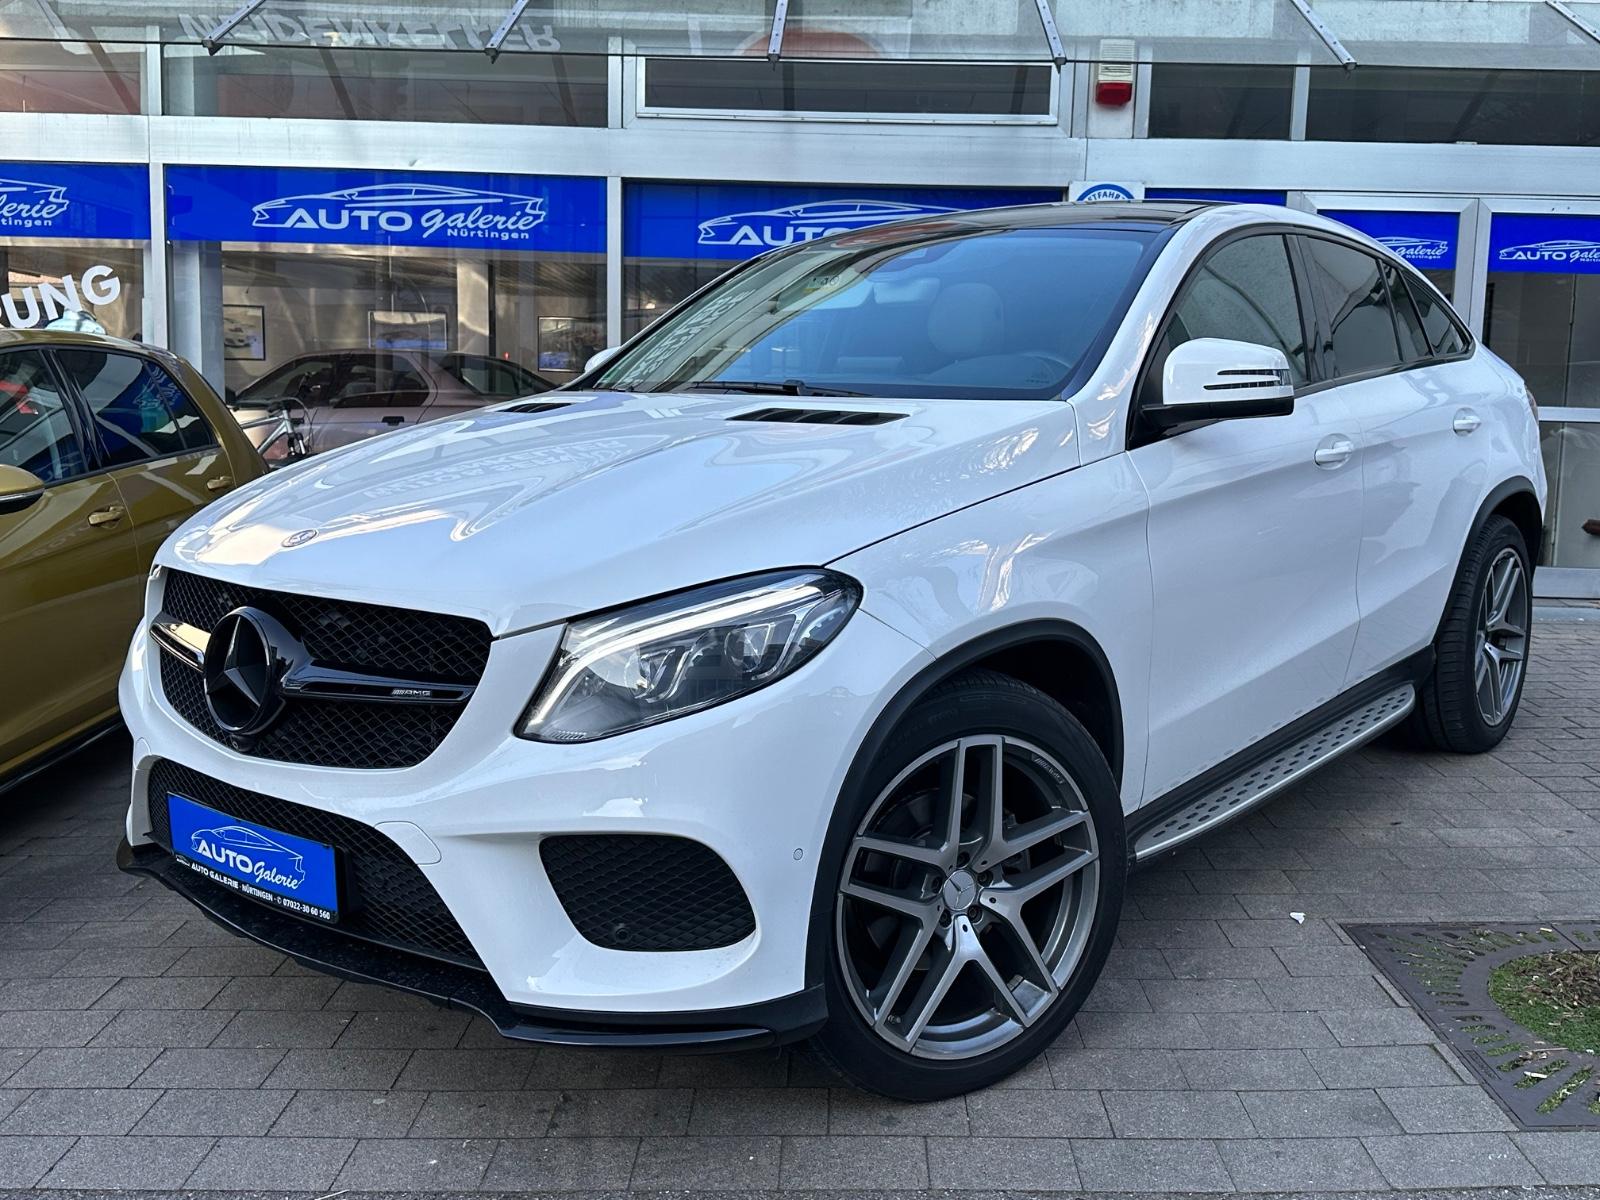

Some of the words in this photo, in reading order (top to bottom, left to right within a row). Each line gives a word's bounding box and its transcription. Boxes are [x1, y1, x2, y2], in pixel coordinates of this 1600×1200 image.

[285, 208, 412, 232] AUTO
[421, 205, 538, 238] galerie
[446, 228, 530, 240] Nürtingen
[1512, 251, 1567, 261] AUTO
[0, 265, 121, 329] UNG
[196, 839, 254, 874] AUTO
[253, 861, 299, 890] Galerie
[191, 862, 209, 876] AUTO
[209, 870, 239, 890] GALERIE
[241, 883, 273, 902] NÜRTINGEN
[310, 906, 319, 916] 60
[319, 909, 332, 920] 560
